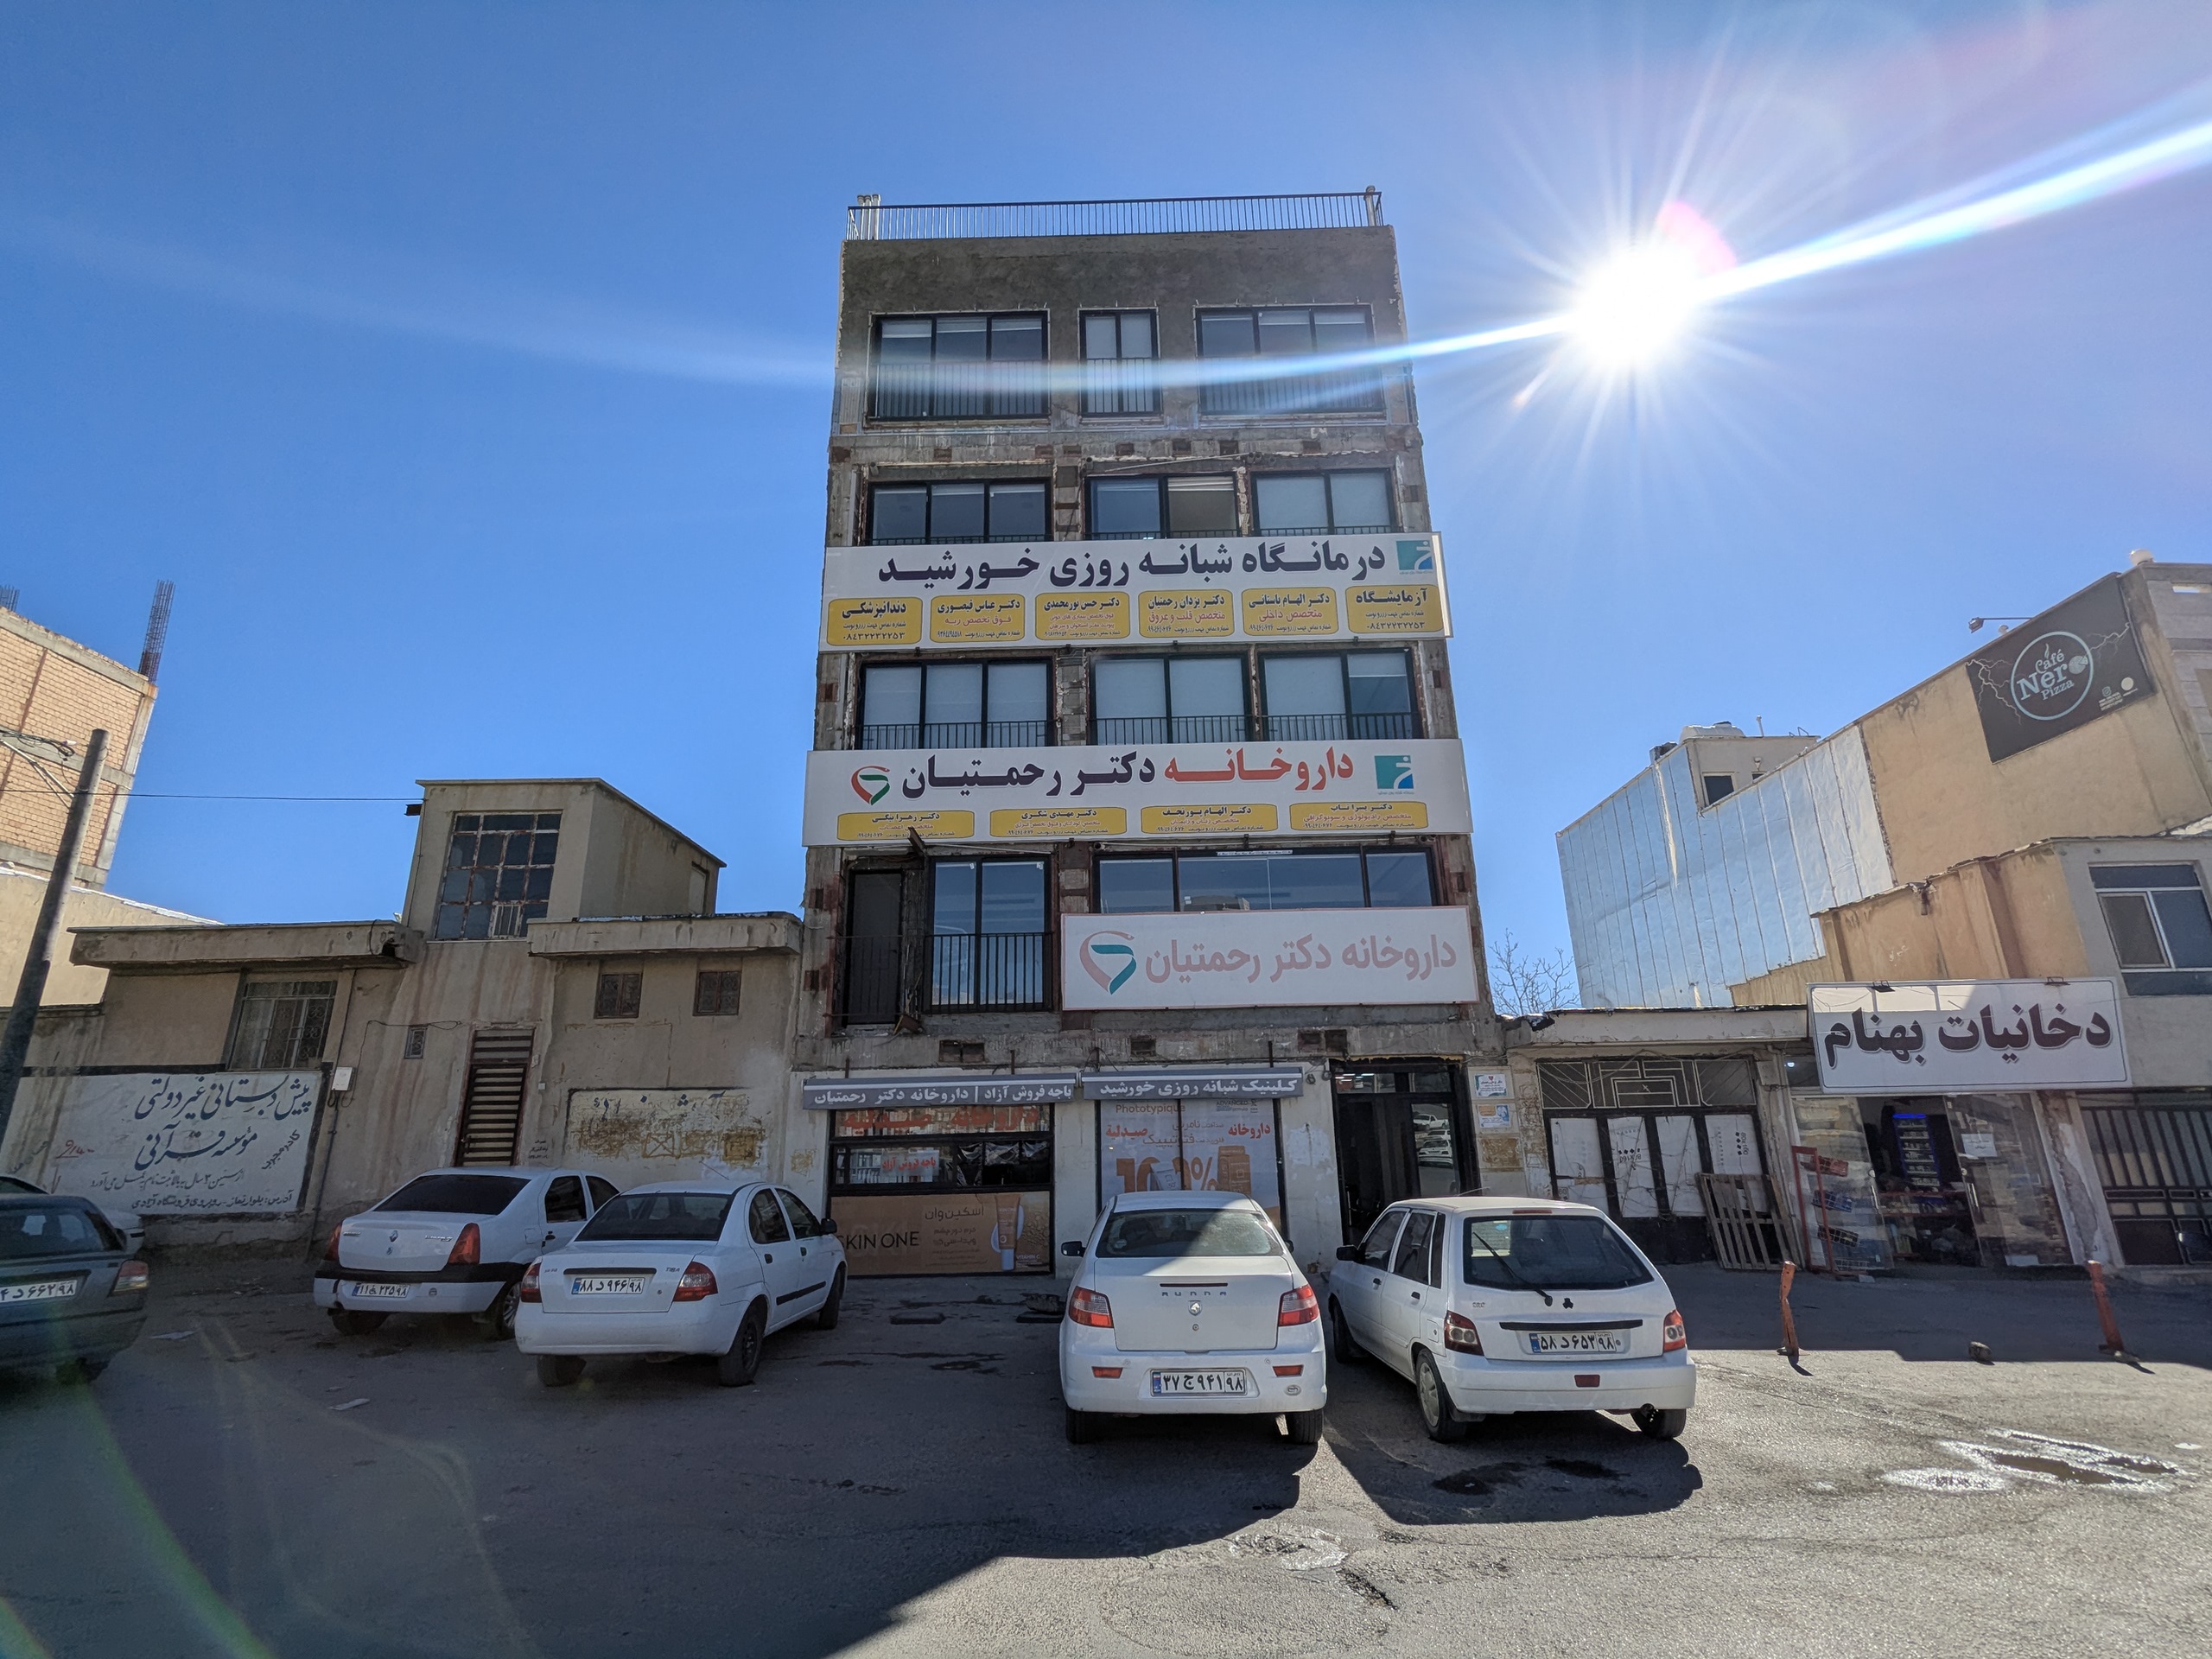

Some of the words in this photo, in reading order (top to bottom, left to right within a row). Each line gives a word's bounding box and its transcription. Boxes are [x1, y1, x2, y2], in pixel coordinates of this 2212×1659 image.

[1139, 543, 1232, 583] شبانه
[1243, 539, 1385, 581] درمانگاه
[879, 548, 1039, 589] خورشید
[1050, 552, 1129, 587] روزی
[1099, 597, 1120, 610] دکتر
[1147, 595, 1177, 609] رحمتیان
[1179, 595, 1200, 608] یزدان
[1203, 594, 1224, 608] دکتر
[1283, 594, 1306, 607] الهام
[1308, 593, 1330, 607] دکتر
[1356, 588, 1427, 606] آزمایشگاه
[842, 601, 906, 619] دندانپزشکی
[975, 601, 995, 613] عباس
[997, 599, 1020, 613] دکتر
[1081, 600, 1097, 610] حسن
[963, 616, 990, 626] تخصص
[992, 615, 1011, 626] فوق
[1148, 612, 1168, 623] عروق
[1170, 614, 1174, 623] و
[1177, 611, 1192, 622] قلب
[1195, 610, 1225, 623] متخصص
[1259, 609, 1283, 622] داخلی
[1286, 609, 1322, 622] متخصص
[2035, 649, 2065, 674] Café
[2041, 680, 2075, 700] Pizza
[903, 753, 1062, 798] رحمتیان
[1071, 750, 1155, 796] دکتر
[1165, 746, 1354, 791] داروخانه
[919, 813, 940, 822] دکتر
[1077, 810, 1097, 818] دکتر
[1204, 807, 1227, 817] الهام
[1230, 806, 1252, 817] دکتر
[1146, 939, 1261, 983] رحمتیان
[1270, 933, 1332, 982] دکتر
[1343, 934, 1457, 981] داروخانه
[1824, 1007, 1925, 1070] بهنام
[1939, 1002, 2111, 1062] دخانیات
[985, 1084, 1009, 1100] آزاد
[1012, 1084, 1046, 1102] فروش
[1047, 1084, 1072, 1099] باجه
[1100, 1082, 1155, 1096] خورشید
[1158, 1083, 1198, 1096] روزی
[1203, 1079, 1238, 1095] شبانه
[1242, 1079, 1298, 1095] کلینیک
[815, 1089, 866, 1104] رحمتیان
[874, 1089, 905, 1104] دکتر
[910, 1086, 969, 1104] داروخانه
[1116, 1103, 1185, 1115] Phototypique
[1173, 1120, 1200, 1131] نامری
[1228, 1122, 1271, 1139] داروخانه
[880, 1231, 919, 1249] ONE
